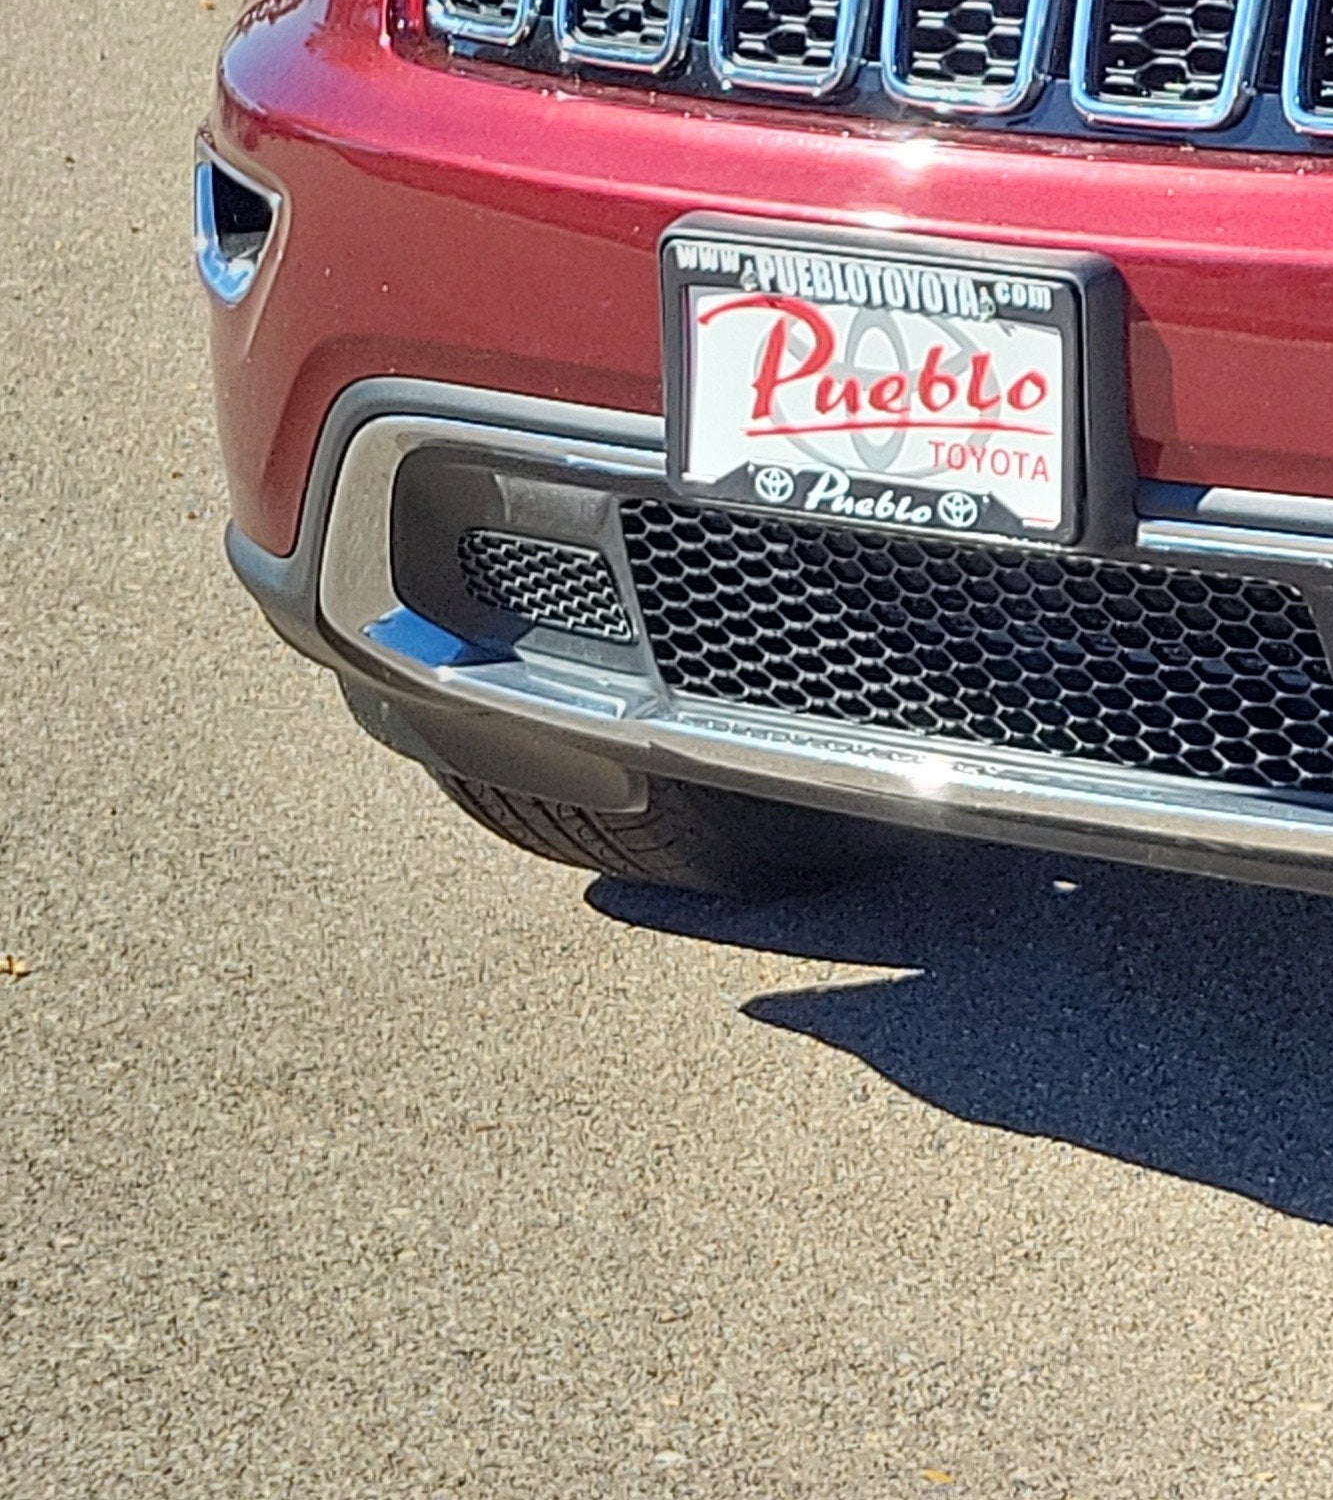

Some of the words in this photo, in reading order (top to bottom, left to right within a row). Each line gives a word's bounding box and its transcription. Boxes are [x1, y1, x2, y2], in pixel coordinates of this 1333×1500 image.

[674, 243, 1053, 321] wwwPUEBLOTOYOTAcom
[697, 295, 1049, 421] Pueblo
[927, 439, 1050, 483] TOYOTA
[805, 469, 933, 525] Pueblo
